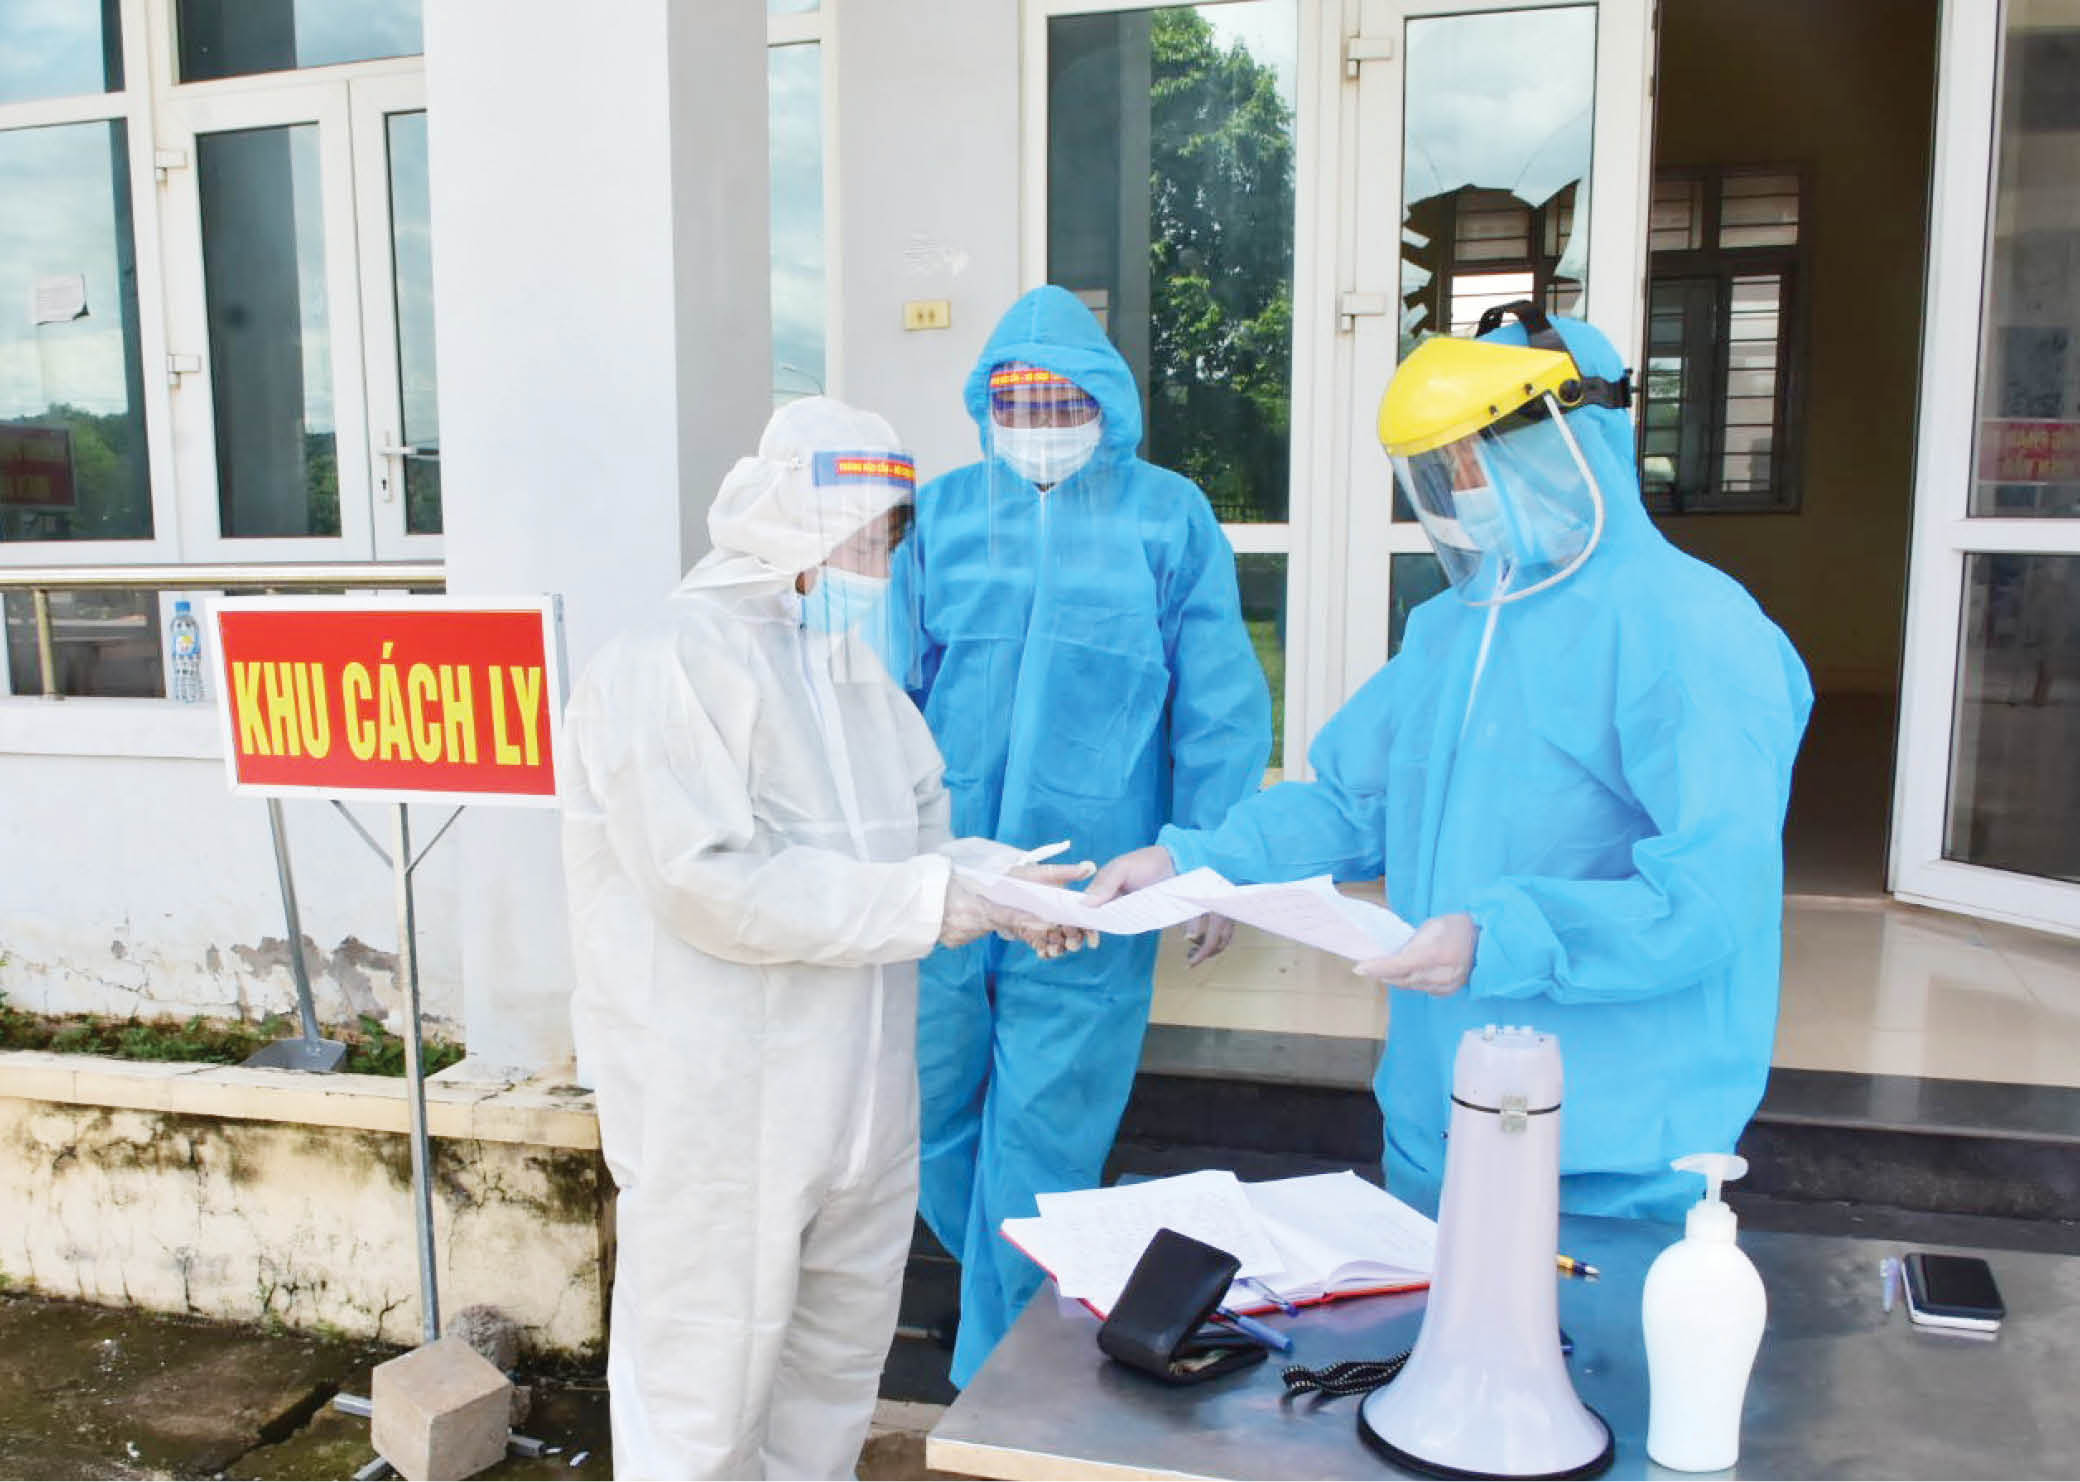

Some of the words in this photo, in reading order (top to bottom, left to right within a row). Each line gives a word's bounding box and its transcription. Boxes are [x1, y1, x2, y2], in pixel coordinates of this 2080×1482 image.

[231, 661, 331, 759] KHU
[342, 641, 478, 764] CÁCH
[488, 665, 541, 766] LY
